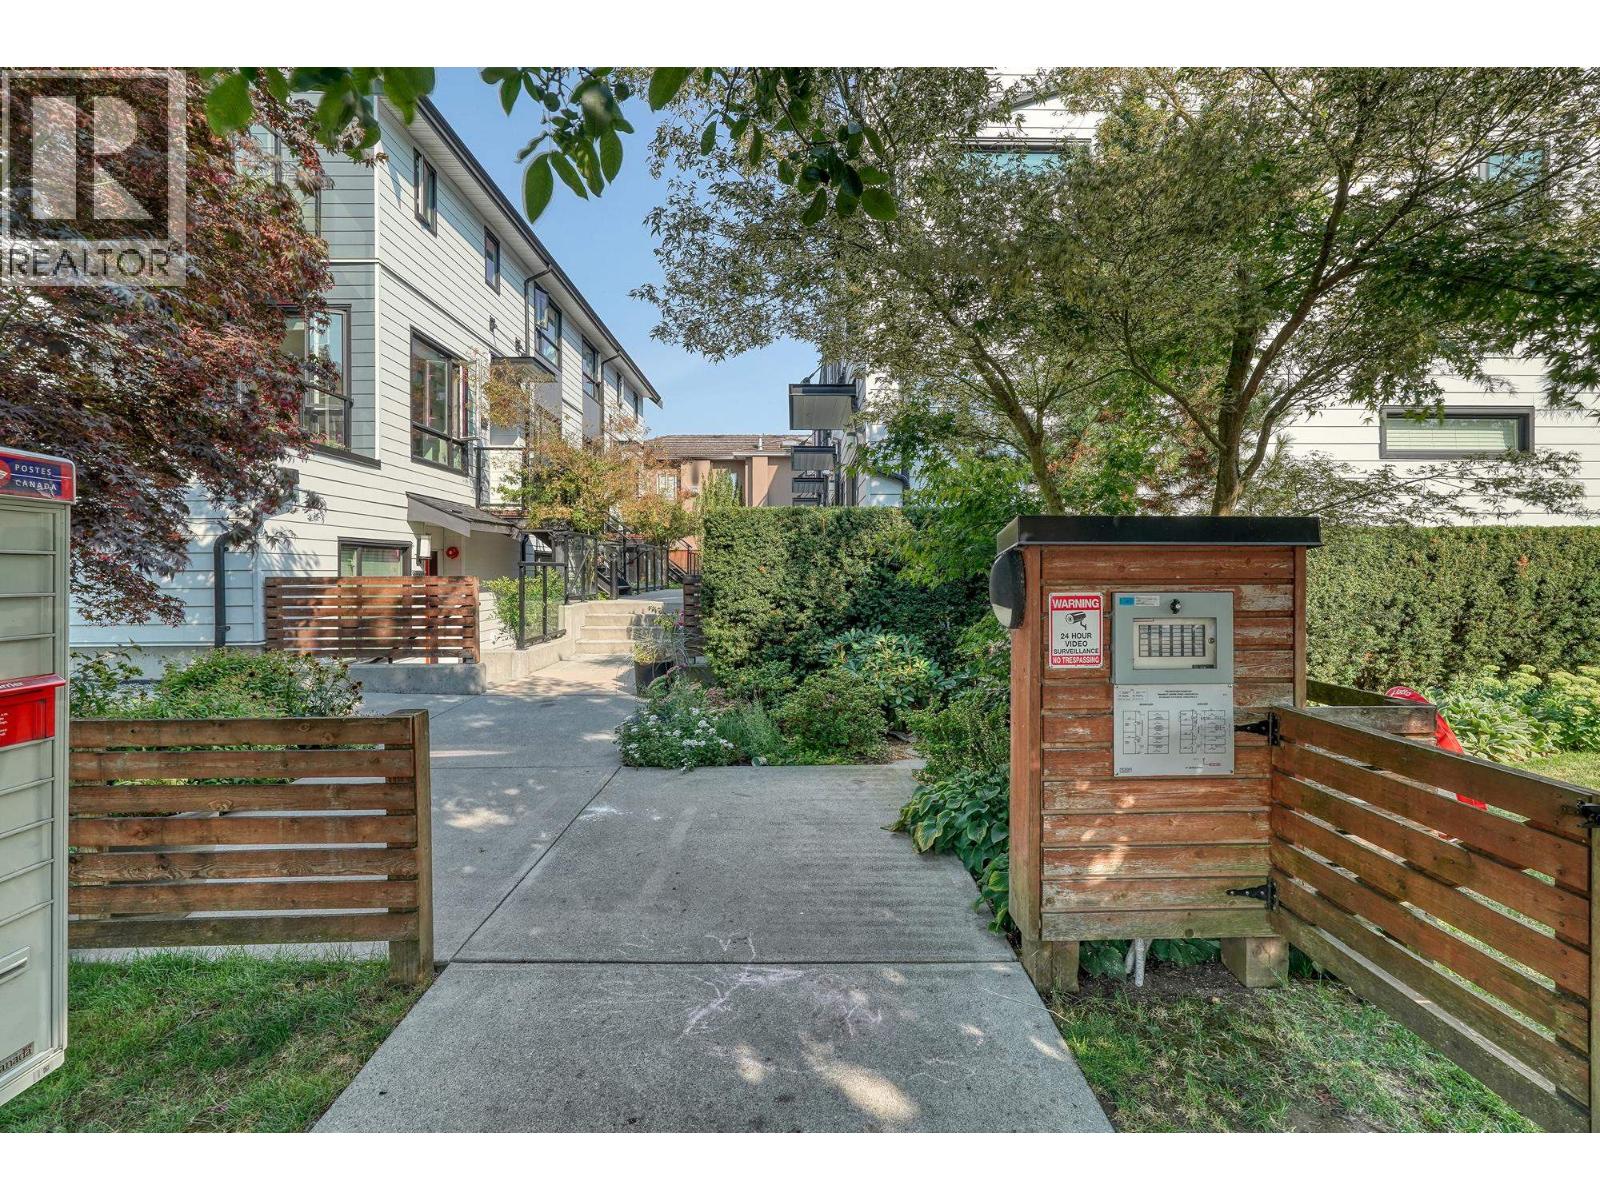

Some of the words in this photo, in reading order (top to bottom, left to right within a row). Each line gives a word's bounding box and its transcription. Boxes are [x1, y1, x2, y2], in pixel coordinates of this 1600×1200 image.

[15, 464, 52, 475] POSTES
[15, 480, 57, 491] CANADA
[1052, 599, 1099, 608] WARNING
[1052, 656, 1061, 664] NO
[1061, 656, 1099, 664] TRESPASSING
